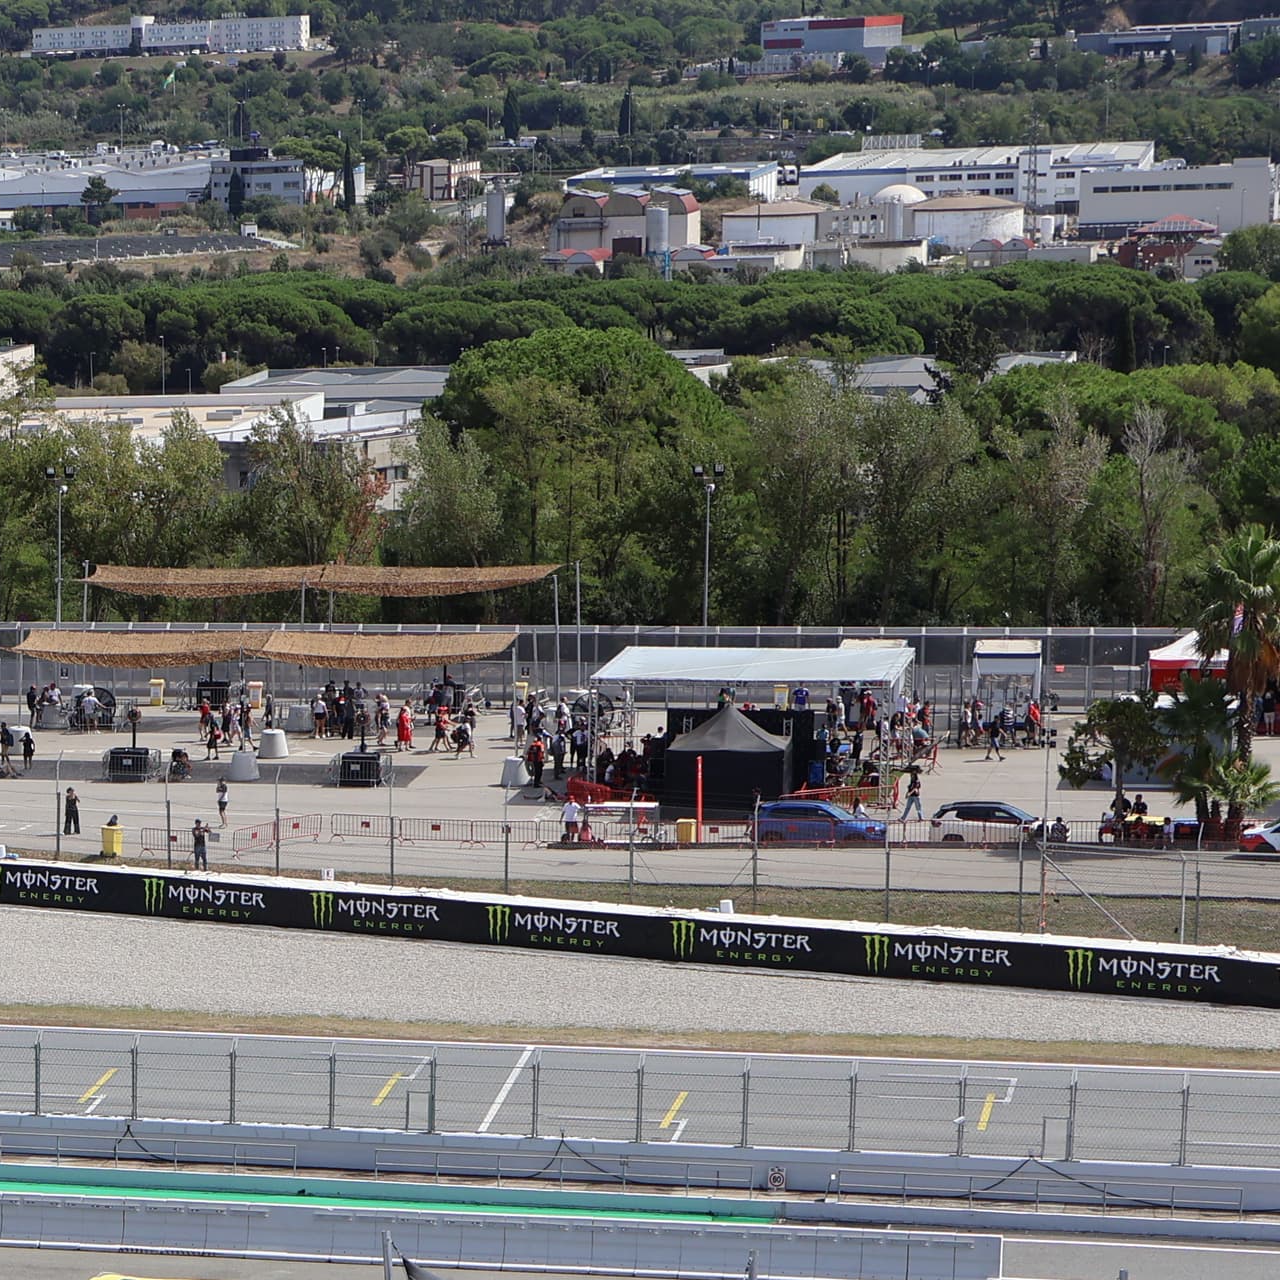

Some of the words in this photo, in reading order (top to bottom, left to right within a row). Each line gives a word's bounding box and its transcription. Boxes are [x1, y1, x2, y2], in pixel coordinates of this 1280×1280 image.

[6, 870, 98, 893] MONSTER
[20, 892, 84, 903] ENERGY
[169, 884, 265, 908] MONSTER
[183, 906, 251, 918] ENERGY
[339, 897, 439, 921] MONSTER
[354, 920, 425, 932] ENERGY
[515, 912, 620, 937] MONSTER
[531, 936, 604, 947] ENERGY
[700, 927, 811, 951] MONSTER
[716, 951, 794, 962] ENERGY
[894, 942, 1011, 966] MONSTER
[912, 965, 993, 977] ENERGY
[1099, 956, 1220, 982] MONSTER
[1117, 981, 1201, 992] ENERGY
